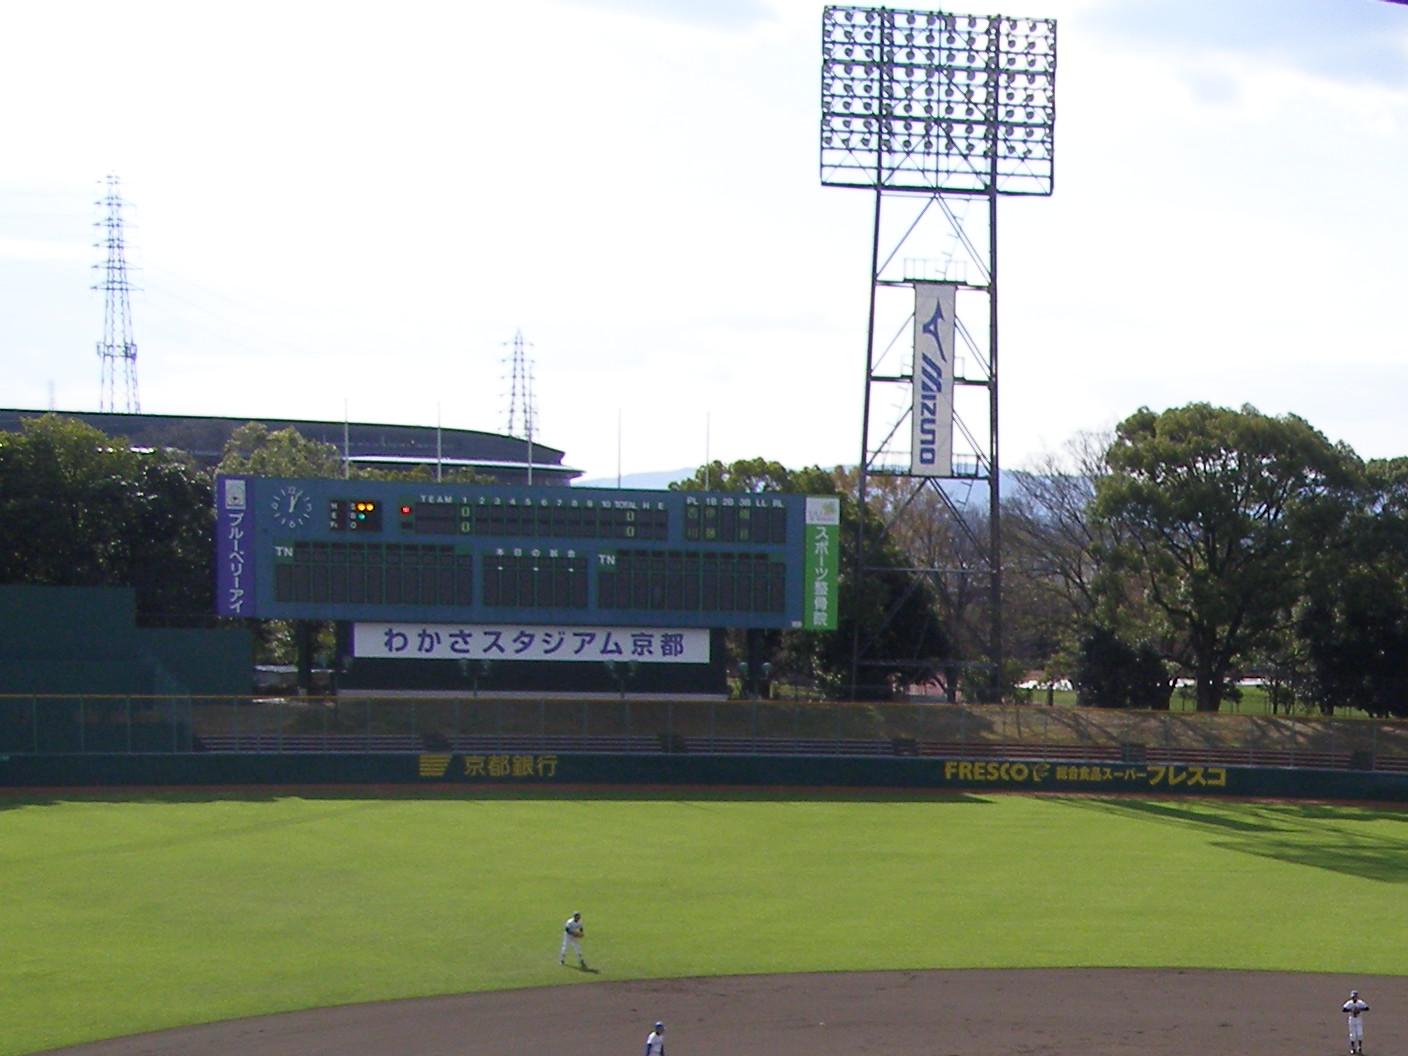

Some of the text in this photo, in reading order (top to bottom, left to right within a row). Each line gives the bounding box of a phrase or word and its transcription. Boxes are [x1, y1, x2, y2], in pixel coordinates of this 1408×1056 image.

[920, 352, 942, 465] MIZUNO
[420, 495, 452, 503] TEAM
[228, 513, 244, 614] ブルーベリーアイ
[274, 546, 294, 557] TN
[598, 554, 616, 565] TN
[813, 526, 829, 627] スポーツ整骨院
[384, 629, 685, 657] わかさスタジアム京都
[463, 755, 557, 777] 京都銀行
[944, 761, 1028, 781] FRESCO
[1147, 766, 1227, 787] フレスコ
